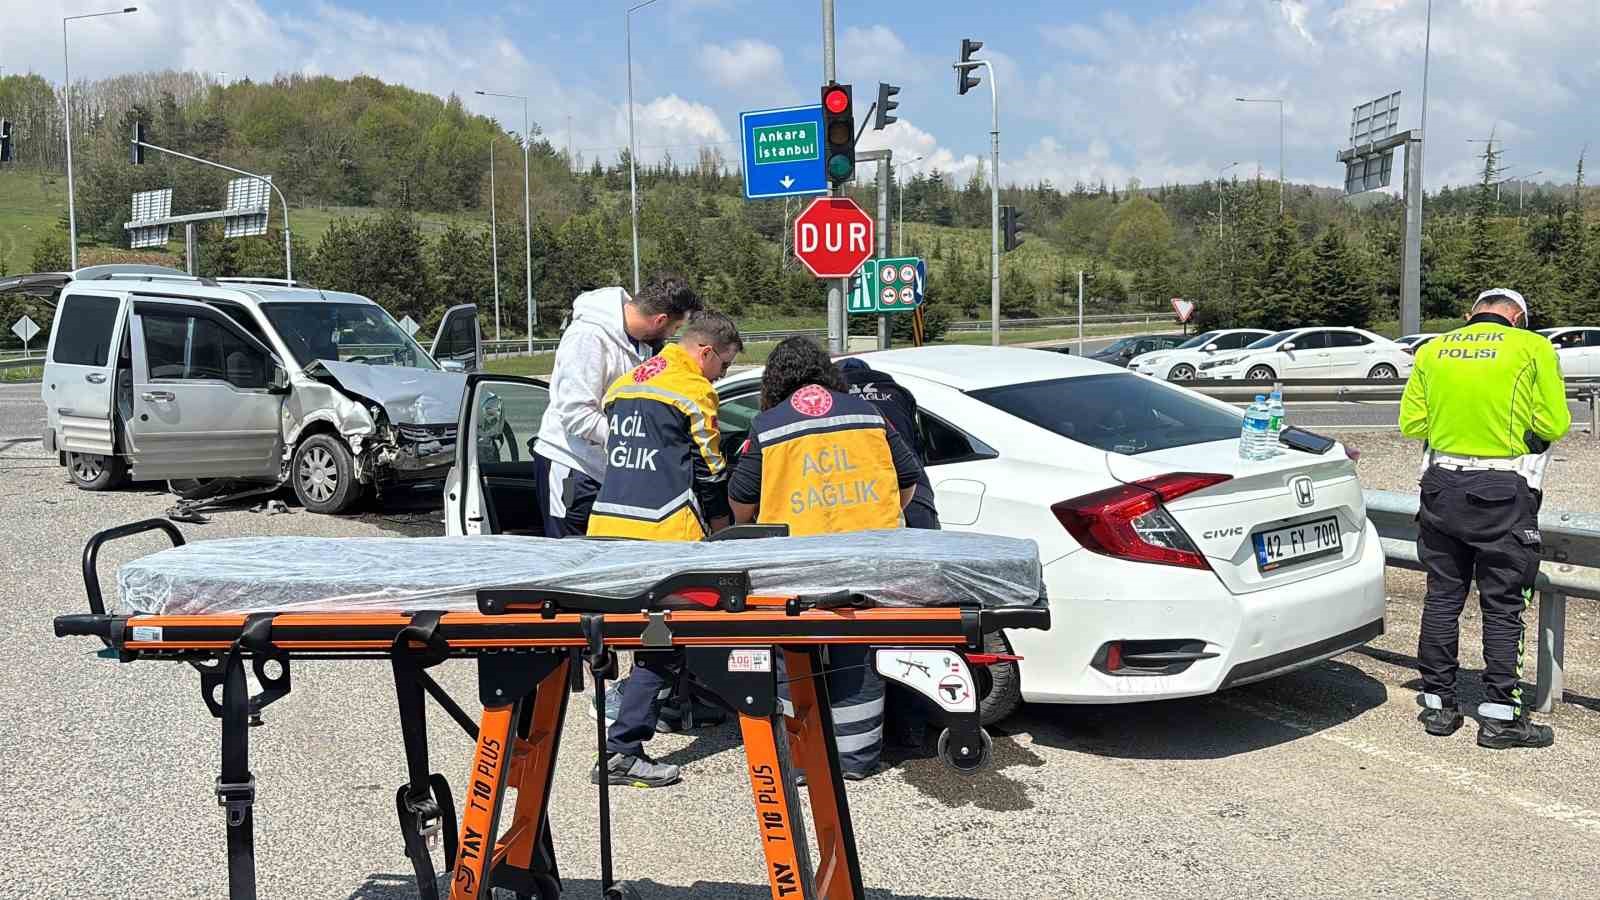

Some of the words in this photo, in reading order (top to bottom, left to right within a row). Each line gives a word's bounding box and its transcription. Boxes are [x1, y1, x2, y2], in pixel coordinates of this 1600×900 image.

[759, 130, 806, 142] Ankara
[801, 223, 866, 252] DUR
[609, 409, 646, 437] ACİL
[606, 440, 660, 472] ĞLIK
[802, 444, 857, 477] ACİL
[791, 478, 880, 514] SAĞLIK
[1202, 526, 1243, 540] CIVIC
[1267, 534, 1283, 559] 42
[1290, 528, 1306, 554] FY
[1314, 522, 1337, 549] 700
[461, 828, 483, 860] TAY
[476, 736, 501, 779] PLUS
[752, 765, 779, 804] PLUS
[773, 862, 798, 897] TAY
